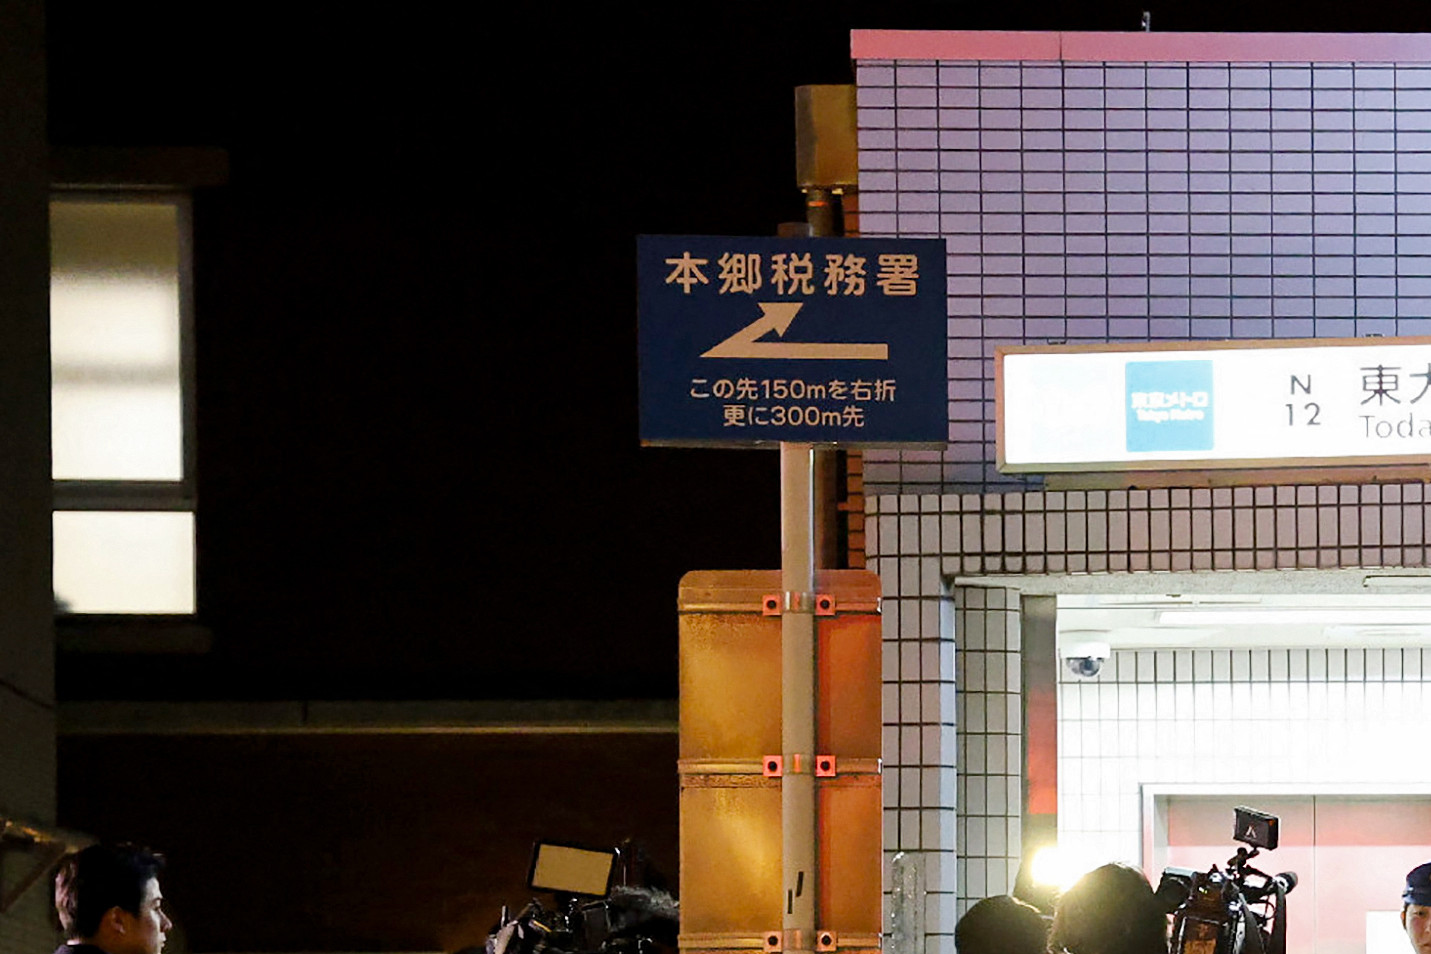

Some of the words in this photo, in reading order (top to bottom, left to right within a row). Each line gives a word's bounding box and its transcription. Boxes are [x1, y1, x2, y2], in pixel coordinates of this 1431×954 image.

[664, 251, 920, 296] 本郷税務署
[690, 377, 896, 401] この先150mを右折
[1290, 375, 1311, 395] N
[723, 405, 865, 427] 更に300m先
[1285, 402, 1321, 426] 12
